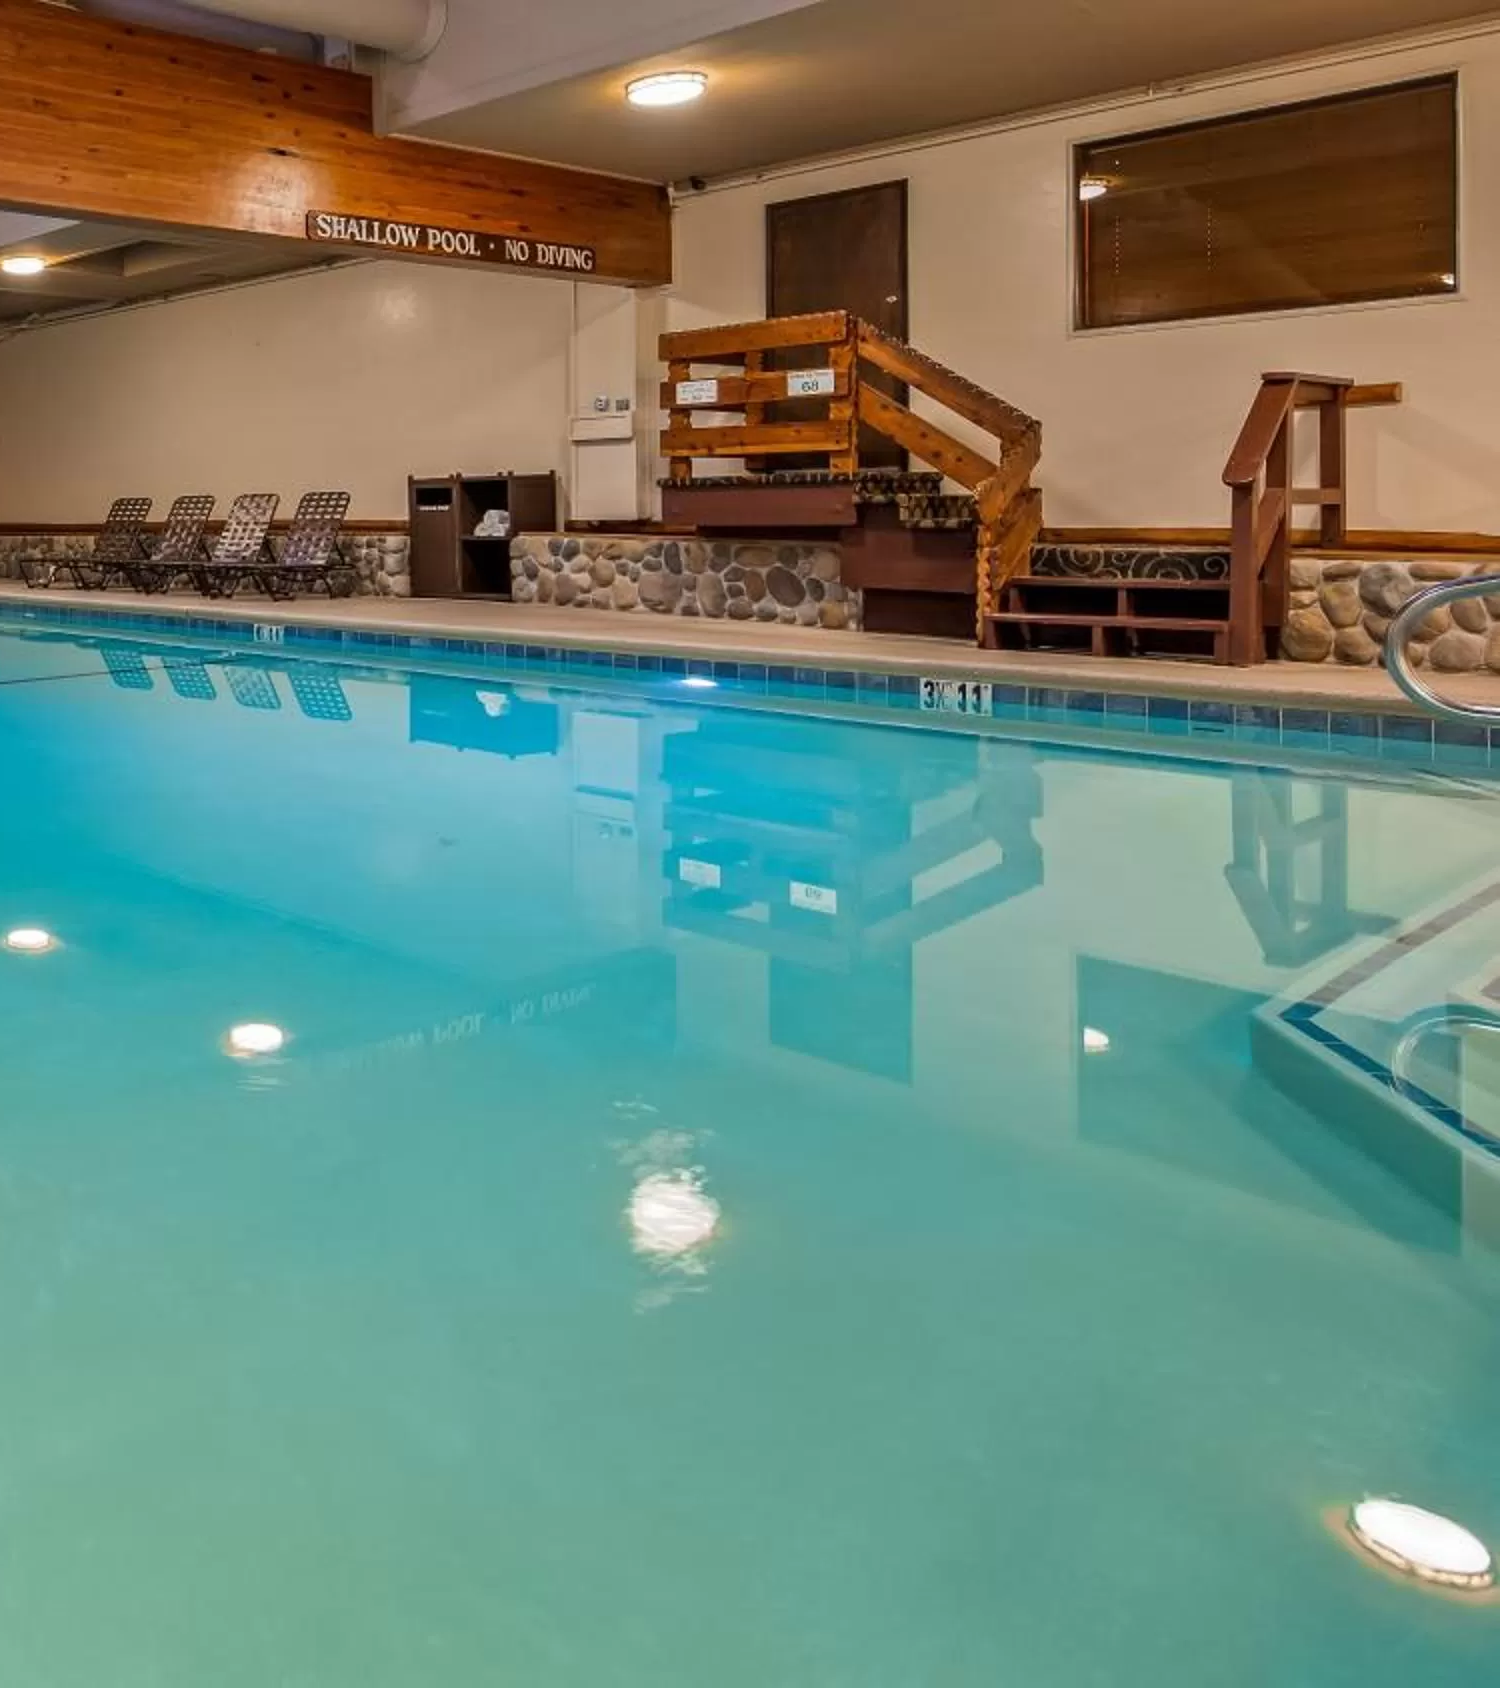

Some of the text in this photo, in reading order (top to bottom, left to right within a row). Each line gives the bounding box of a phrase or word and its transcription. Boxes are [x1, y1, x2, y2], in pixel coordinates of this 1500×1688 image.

[316, 213, 593, 270] SHALLOW POOL NO DIVING
